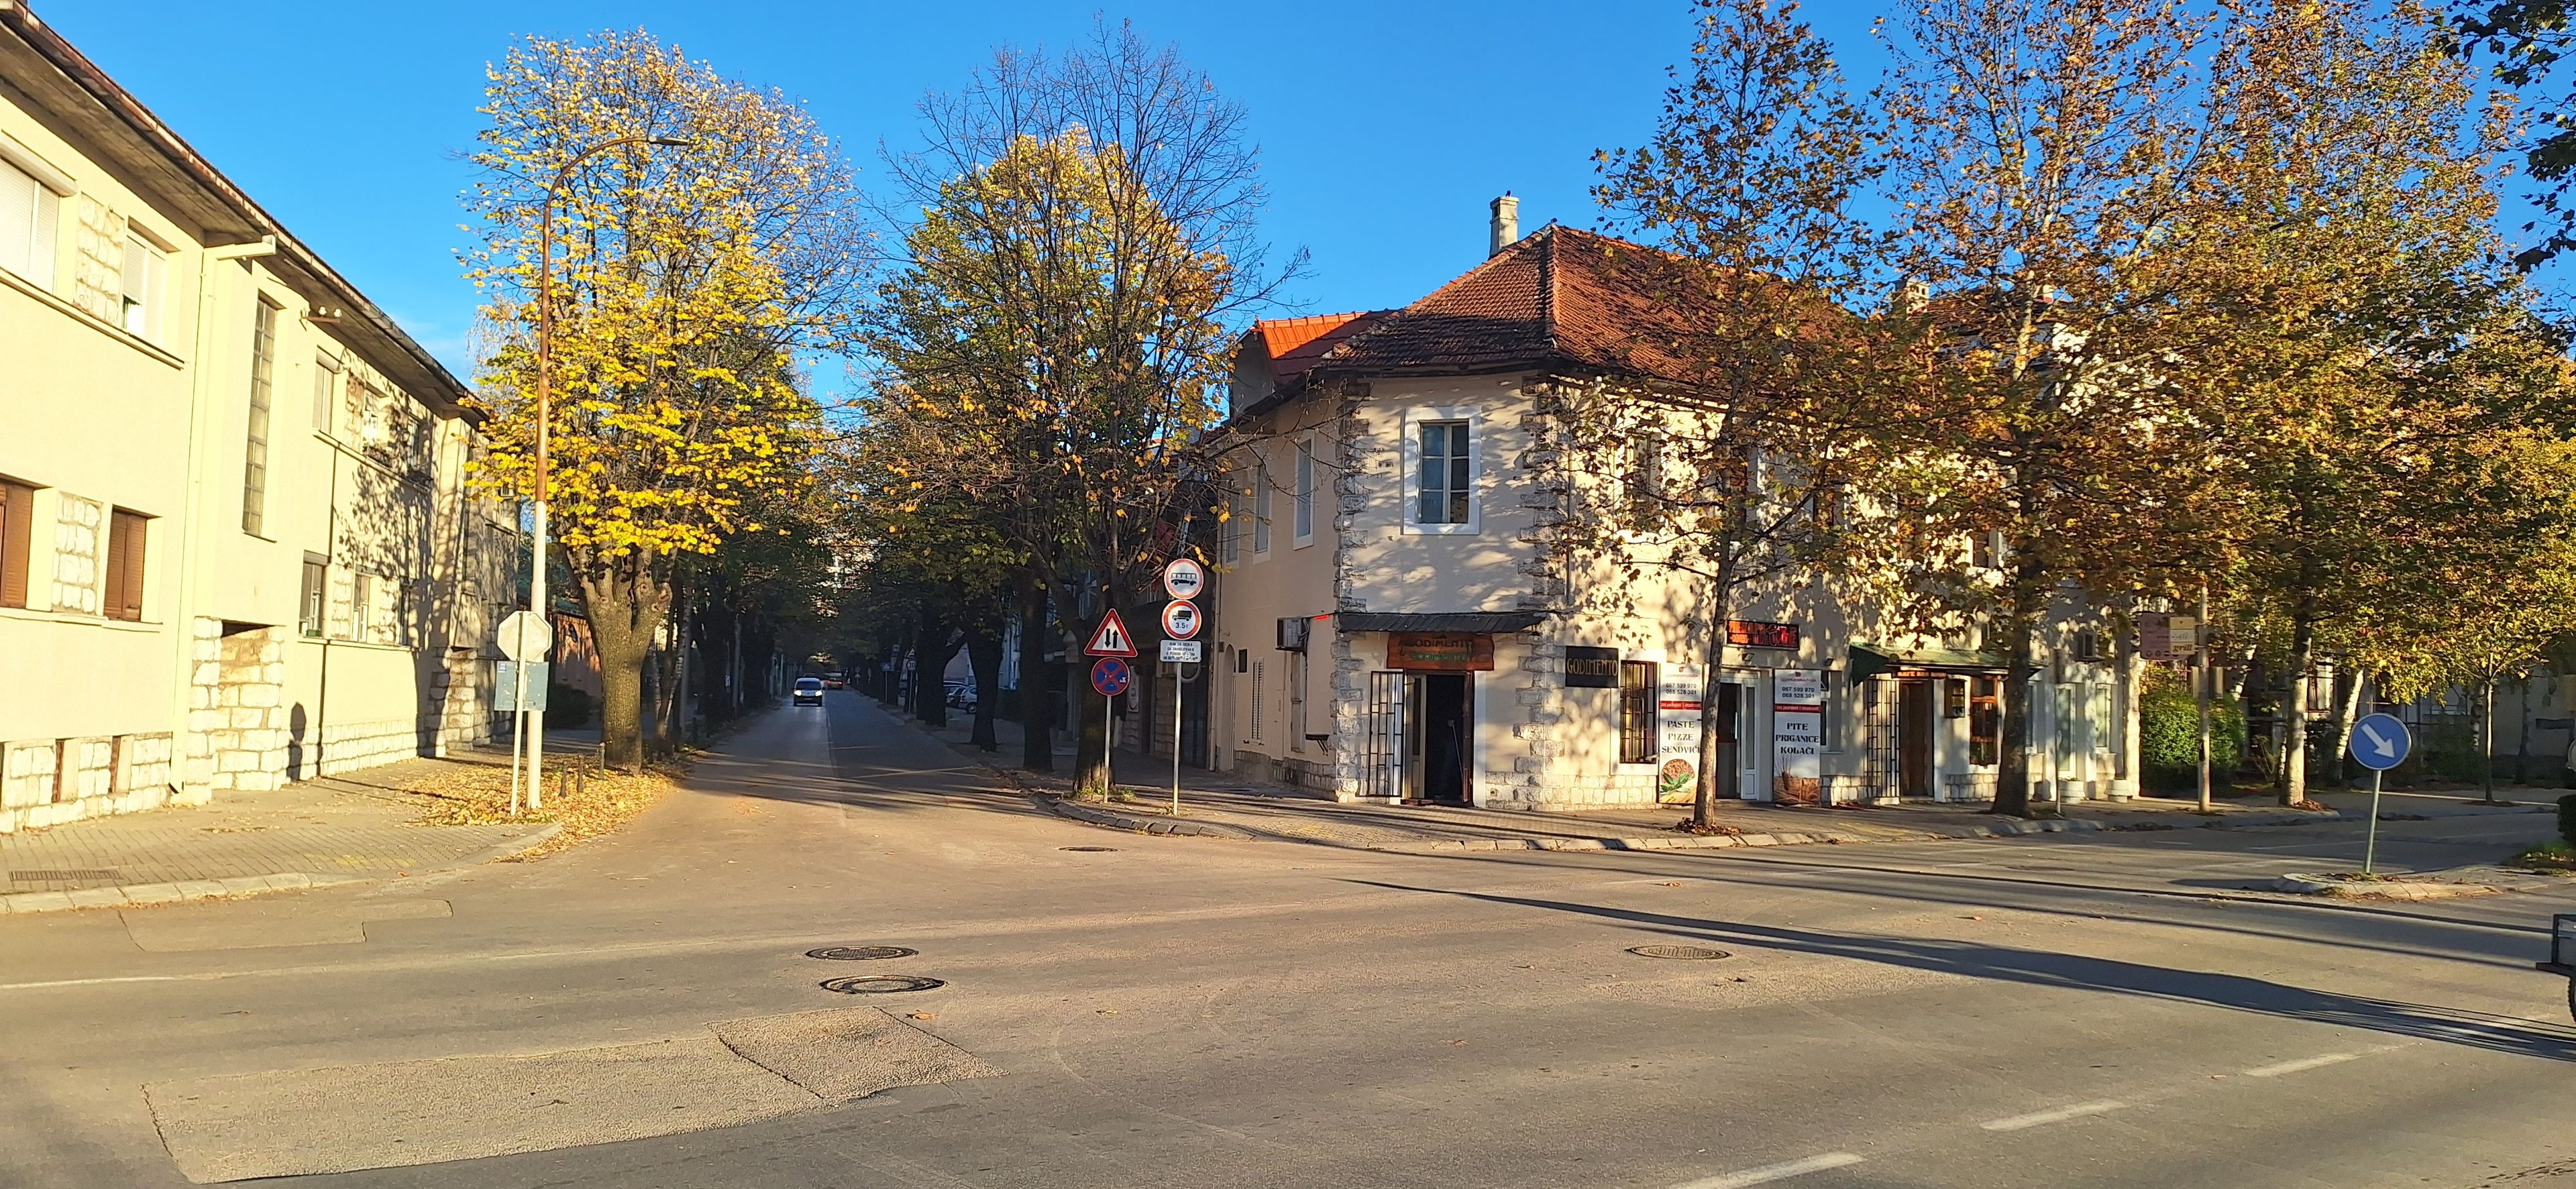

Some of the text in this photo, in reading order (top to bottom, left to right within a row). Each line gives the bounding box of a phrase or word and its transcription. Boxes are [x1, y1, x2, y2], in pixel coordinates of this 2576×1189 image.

[2173, 644, 2193, 653] grill
[1566, 658, 1618, 677] GODIMENTO
[1667, 720, 1695, 728] PASTE
[1787, 722, 1809, 730] PITE
[1668, 733, 1694, 741] PIZZE
[1776, 734, 1819, 743] PRIGANICE
